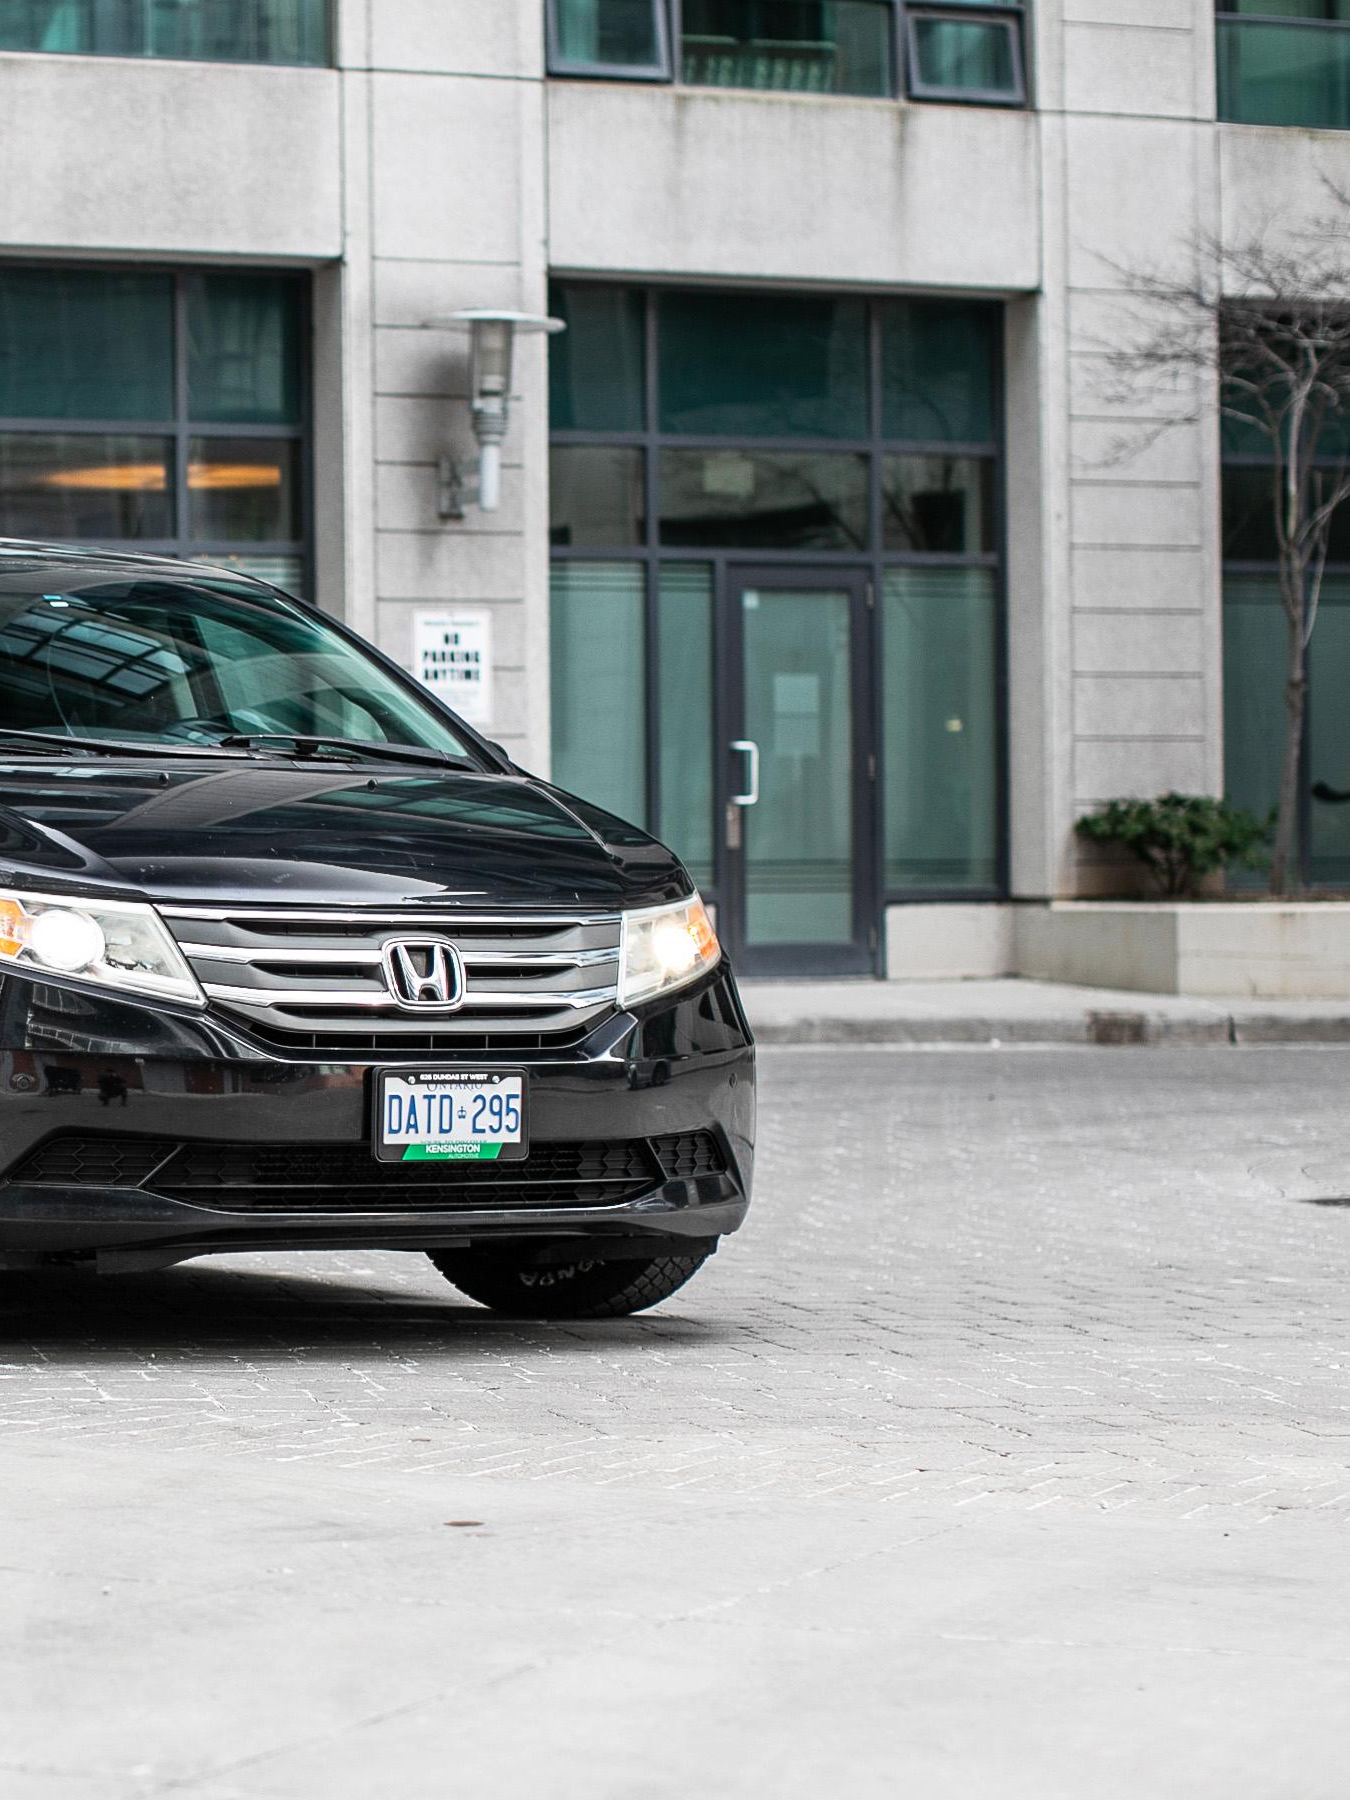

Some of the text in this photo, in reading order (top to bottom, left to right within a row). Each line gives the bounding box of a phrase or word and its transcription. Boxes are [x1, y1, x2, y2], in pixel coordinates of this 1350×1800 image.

[433, 1073, 459, 1081] DUNDAS
[460, 1073, 469, 1081] ST
[469, 1073, 489, 1081] WEST
[387, 1093, 521, 1135] DATD 295
[425, 1144, 481, 1154] KENSINGTON
